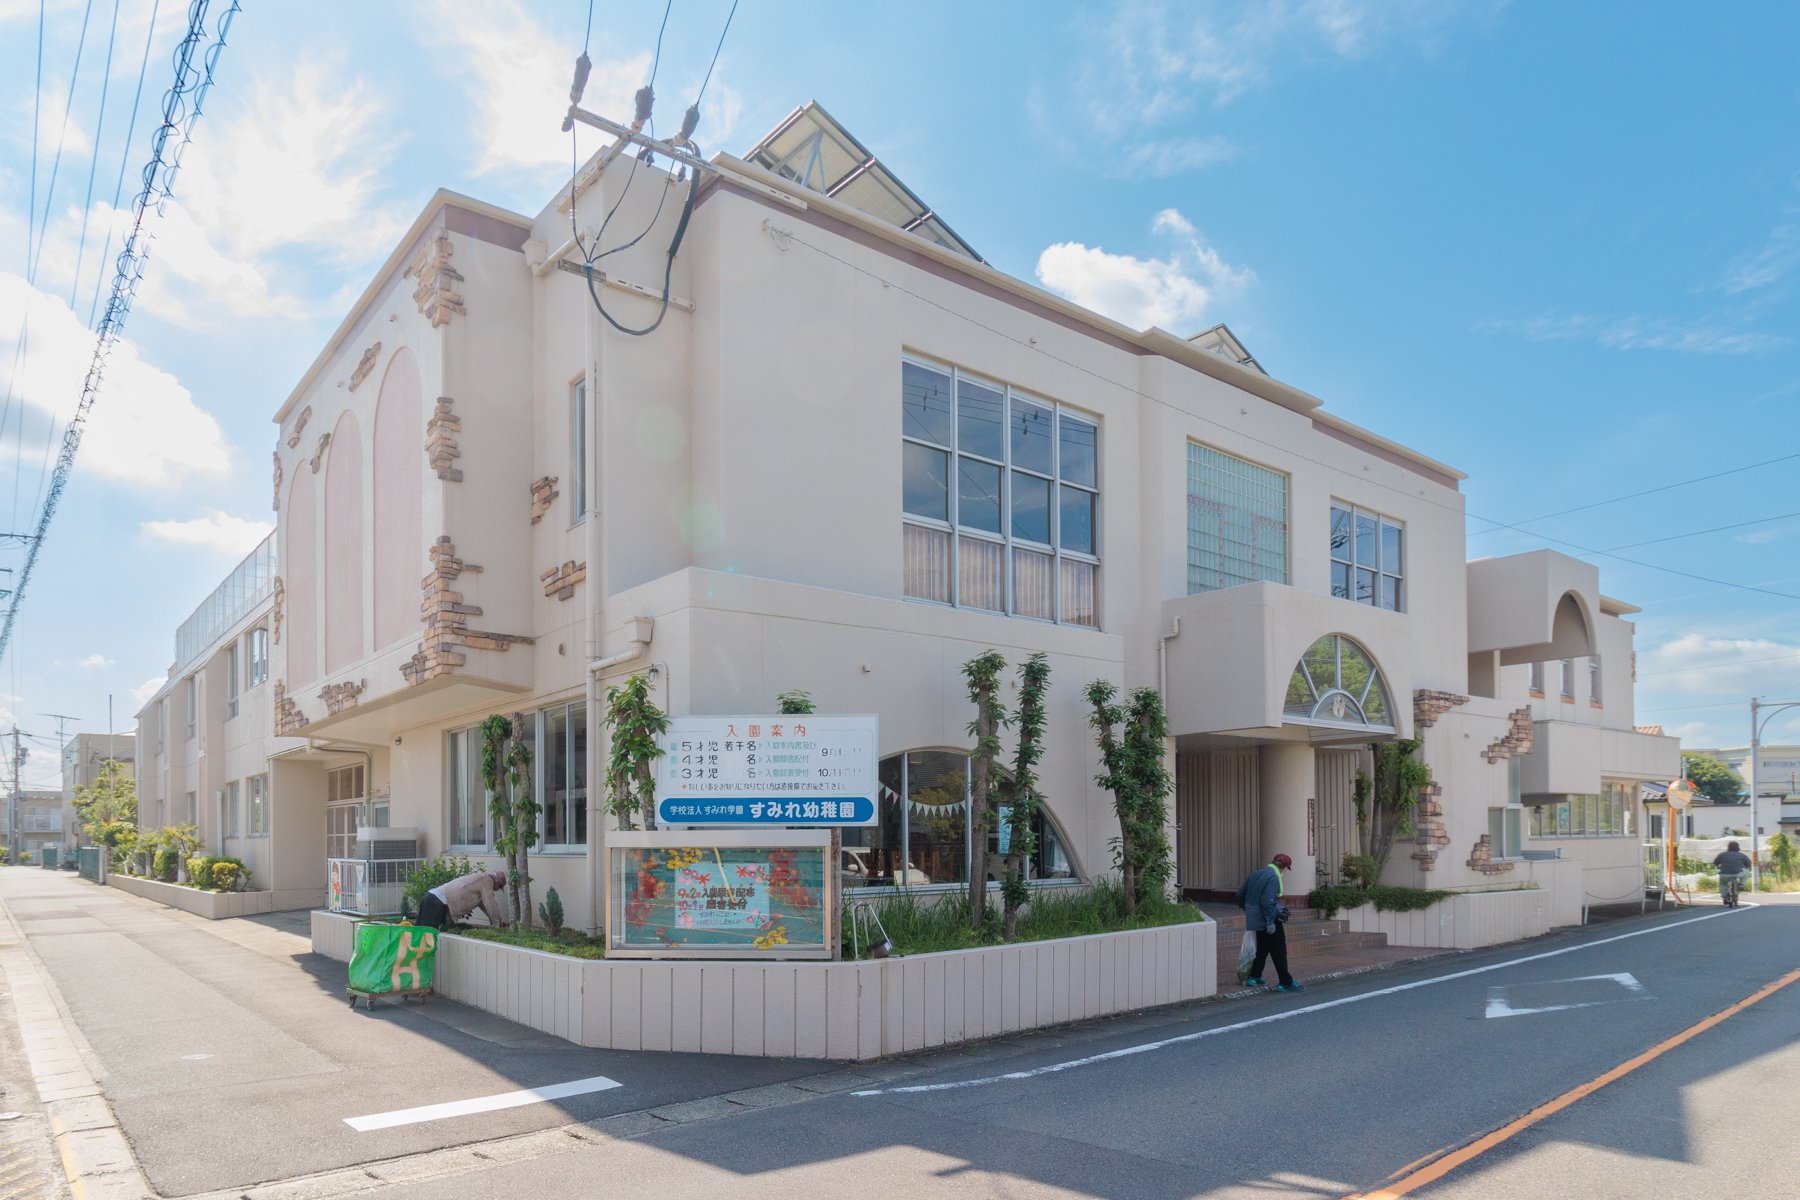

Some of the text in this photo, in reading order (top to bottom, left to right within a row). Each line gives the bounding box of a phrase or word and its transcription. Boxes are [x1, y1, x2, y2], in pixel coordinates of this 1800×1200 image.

[726, 724, 806, 738] 入園案内
[682, 754, 756, 765] 4才児 名
[682, 768, 718, 779] 3才児
[749, 801, 855, 818] すみれ幼稚園
